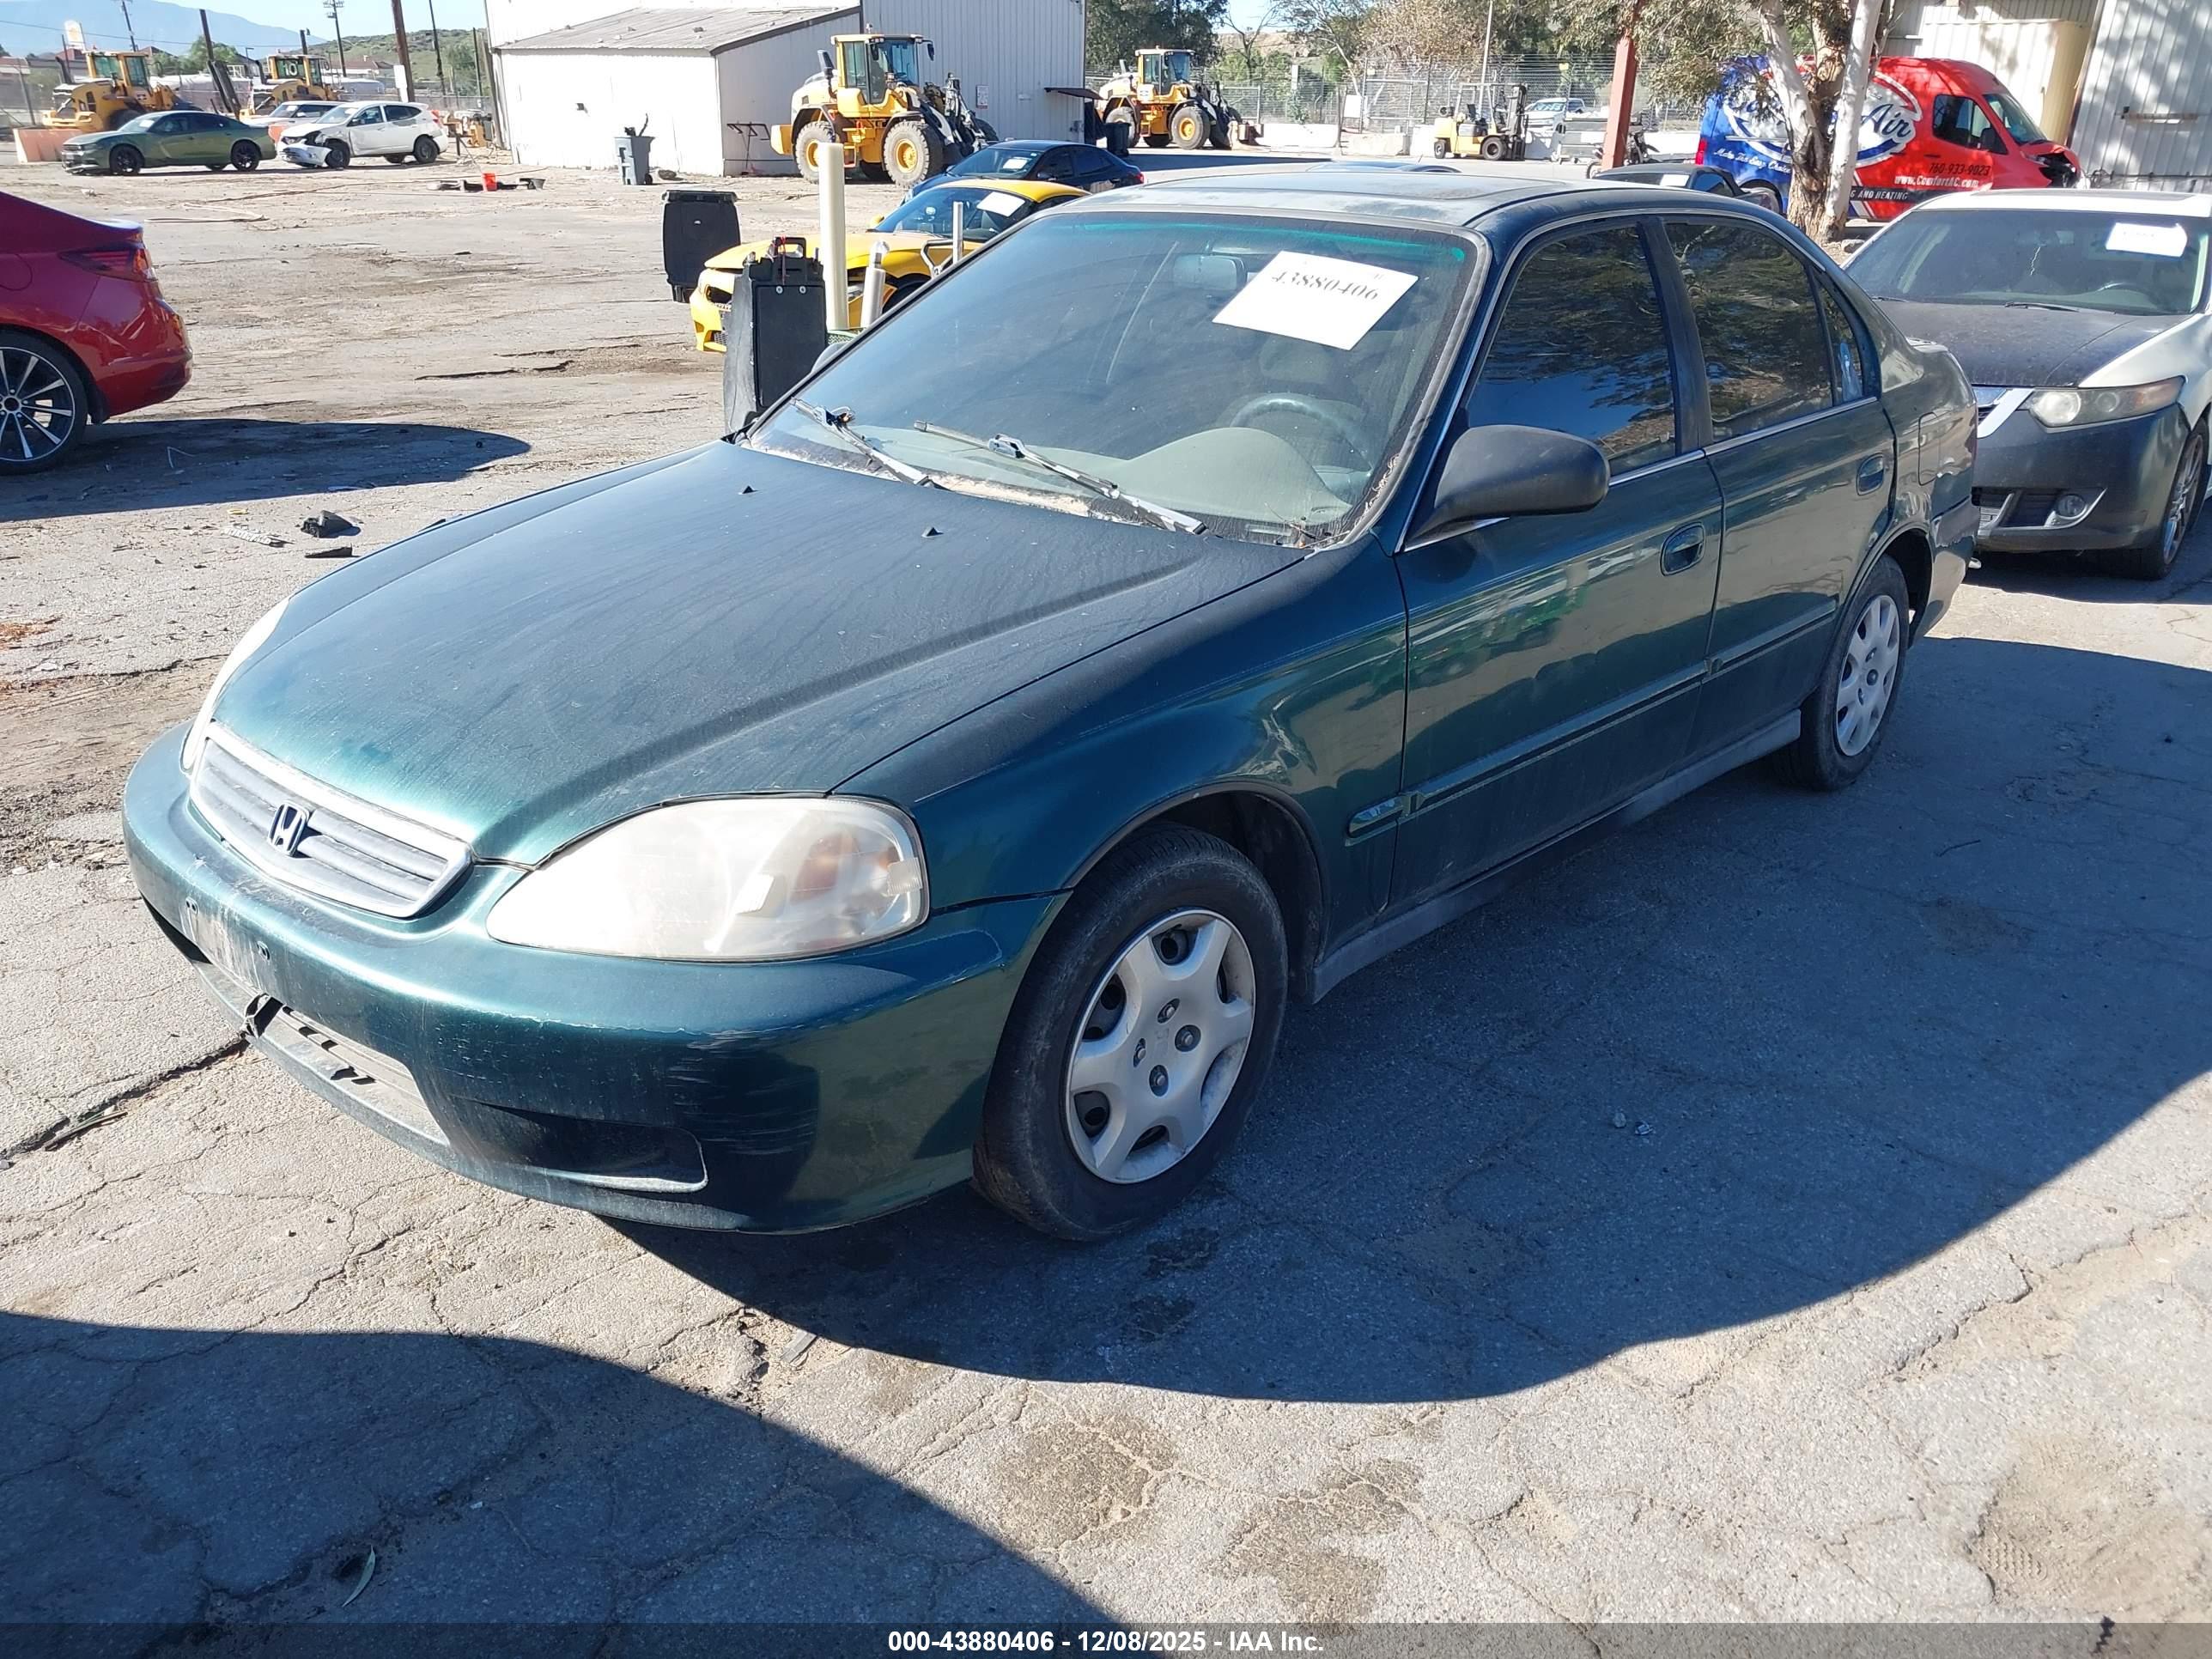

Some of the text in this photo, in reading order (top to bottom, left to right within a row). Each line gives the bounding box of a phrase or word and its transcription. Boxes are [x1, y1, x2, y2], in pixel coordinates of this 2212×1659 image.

[1861, 103, 1911, 137] Air
[1929, 162, 1991, 176] 760-933-9023
[1894, 175, 1979, 188] www.ComfortAC.com
[1857, 190, 1874, 199] AND
[1875, 191, 1909, 200] HEATING
[1271, 270, 1379, 301] 43880406
